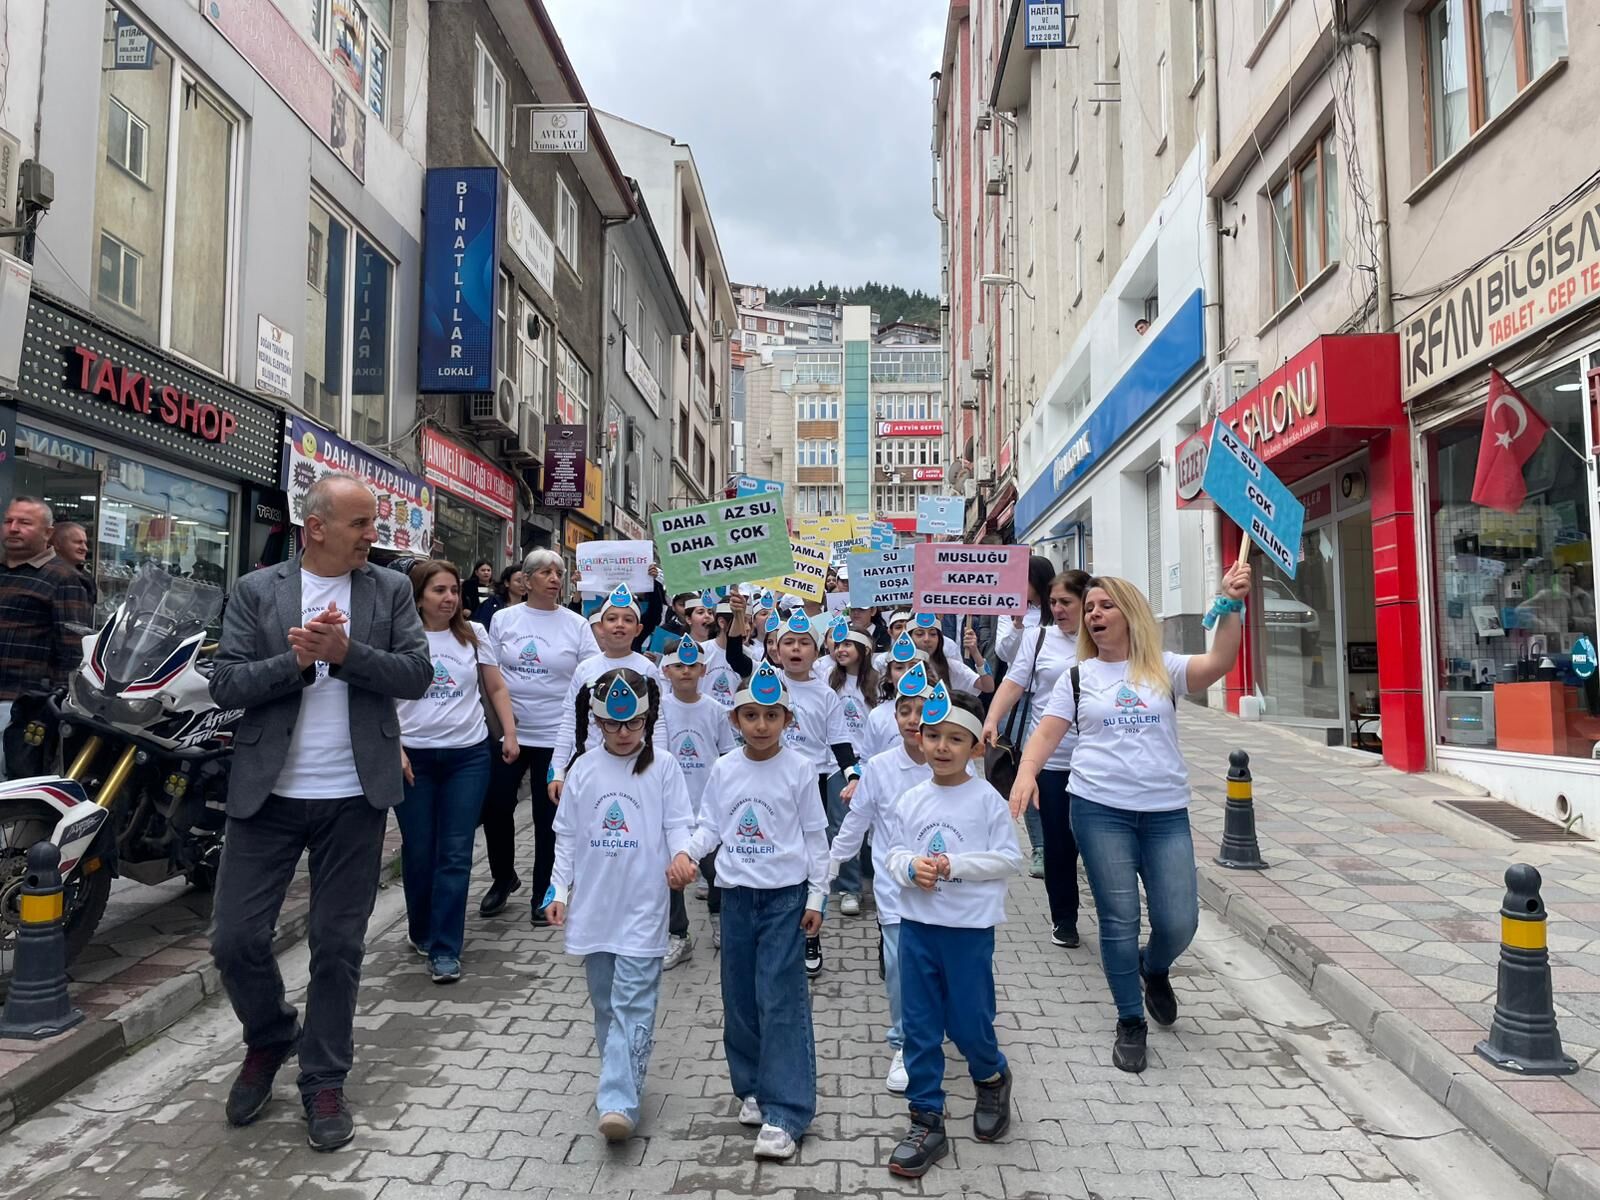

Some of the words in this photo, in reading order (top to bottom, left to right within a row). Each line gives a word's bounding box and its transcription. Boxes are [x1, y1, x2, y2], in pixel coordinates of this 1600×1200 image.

[540, 130, 578, 140] AVUKAT
[450, 181, 468, 359] BİNATLILAR
[1488, 300, 1536, 348] TABLET
[1548, 279, 1576, 316] CEP
[1406, 277, 1484, 388] İRFAN
[438, 366, 473, 376] LOKALİ
[75, 345, 152, 414] TAKI
[160, 386, 239, 444] SHOP
[1242, 361, 1318, 452] SALONU
[1222, 434, 1239, 455] AZ
[1240, 451, 1260, 478] SU,
[324, 441, 356, 472] DAHA
[359, 458, 372, 479] NE
[374, 464, 417, 500] YAPALIM
[1248, 486, 1272, 517] ÇOK
[662, 514, 706, 532] DAHA
[724, 506, 746, 520] AZ
[750, 501, 777, 516] SU,
[670, 536, 715, 554] DAHA
[730, 525, 765, 542] ÇOK
[1252, 518, 1292, 568] BİLİNÇ.
[702, 552, 758, 571] YAŞAM
[883, 552, 898, 561] SU
[938, 552, 1008, 563] MUSLUĞU
[784, 577, 816, 594] ETME.
[880, 578, 909, 588] BOŞA
[948, 573, 998, 586] KAPAT,
[924, 594, 992, 606] GELECEĞİ
[996, 597, 1020, 609] AÇ.
[430, 690, 464, 699] ELÇİLERİ
[1104, 718, 1116, 727] SU
[1118, 714, 1160, 725] ELÇİLERİ
[590, 840, 600, 848] SU
[602, 838, 639, 848] ELÇİLERİ
[736, 845, 775, 854] ELÇİLERİ
